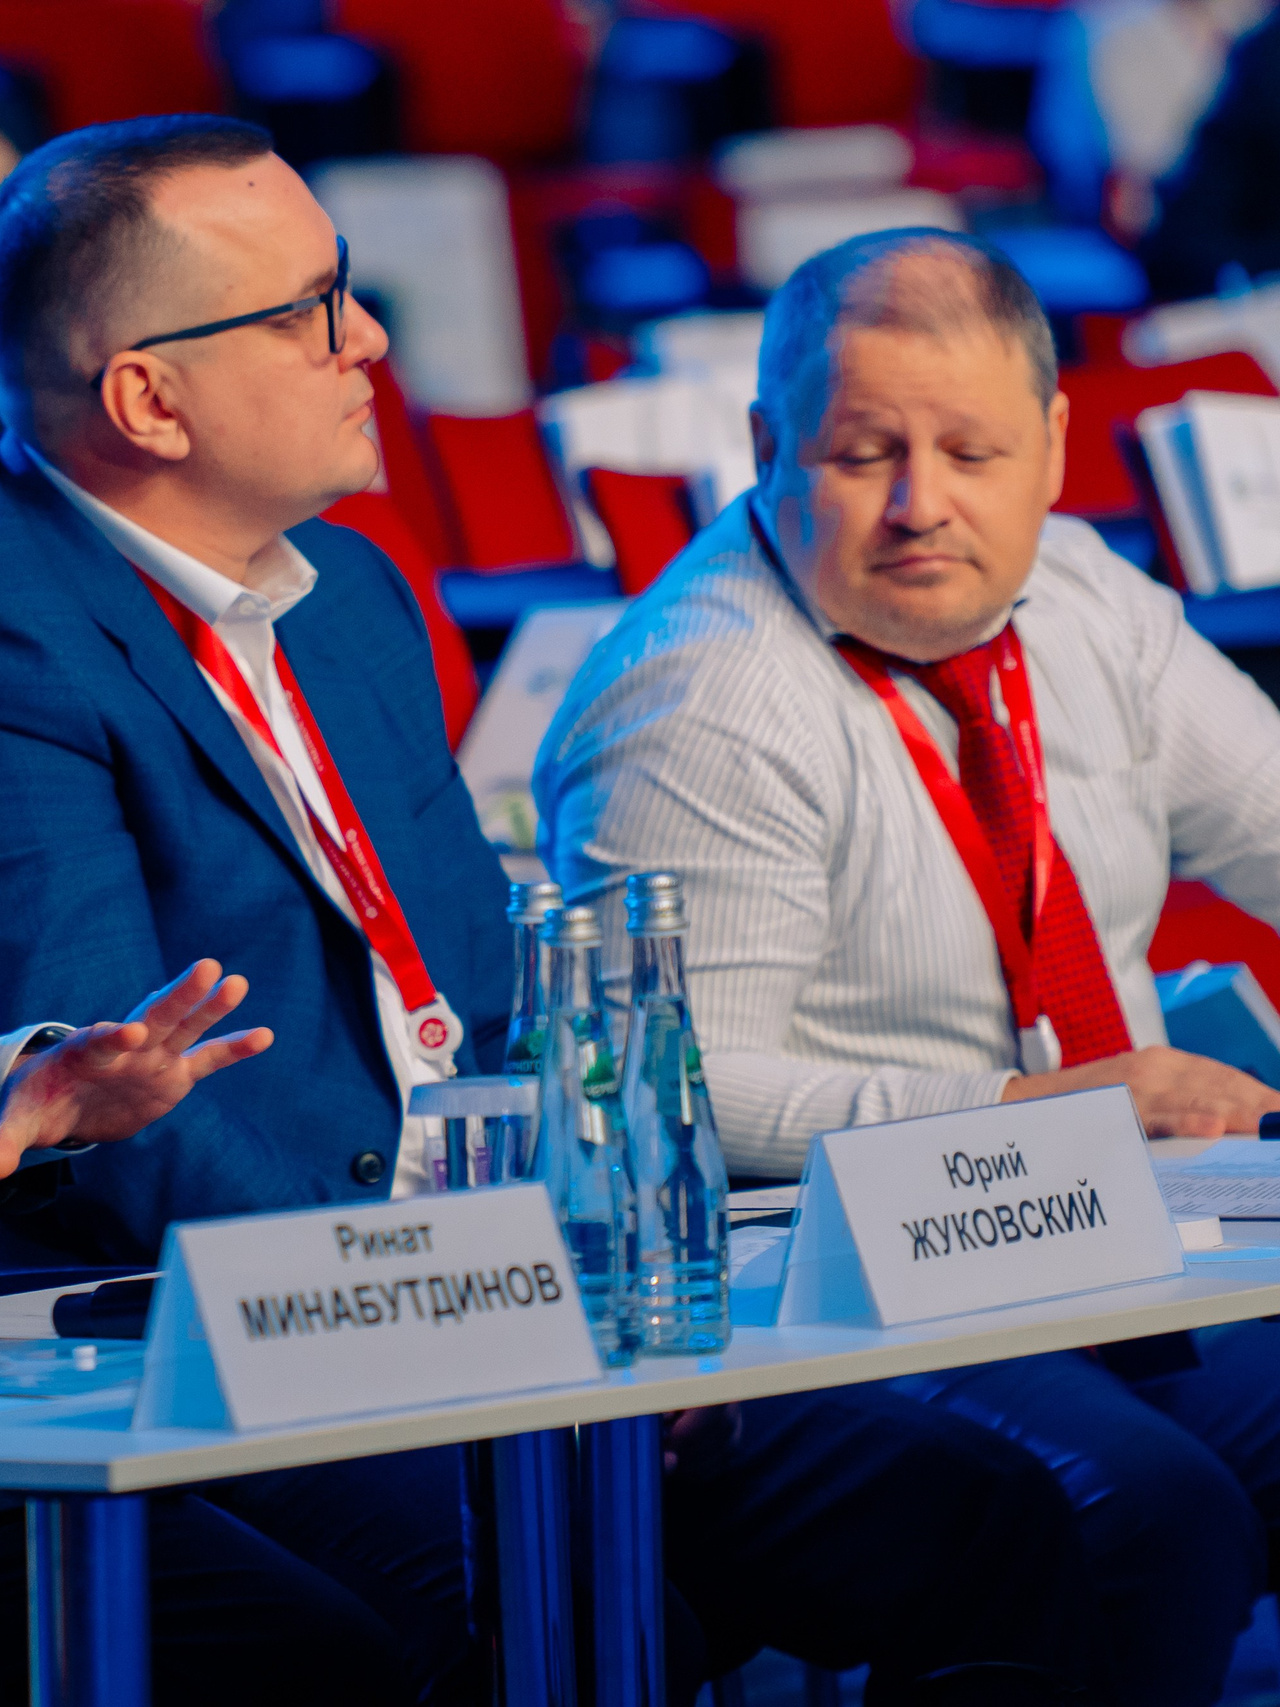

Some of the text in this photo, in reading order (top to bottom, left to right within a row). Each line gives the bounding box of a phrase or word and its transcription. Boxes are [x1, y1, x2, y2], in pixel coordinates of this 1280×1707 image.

[942, 1141, 1029, 1193] Юрий
[333, 1223, 434, 1261] Ринат
[901, 1178, 1108, 1262] ЖУКОВСКИЙ
[237, 1262, 562, 1343] МИНАБУТДИНОВ
